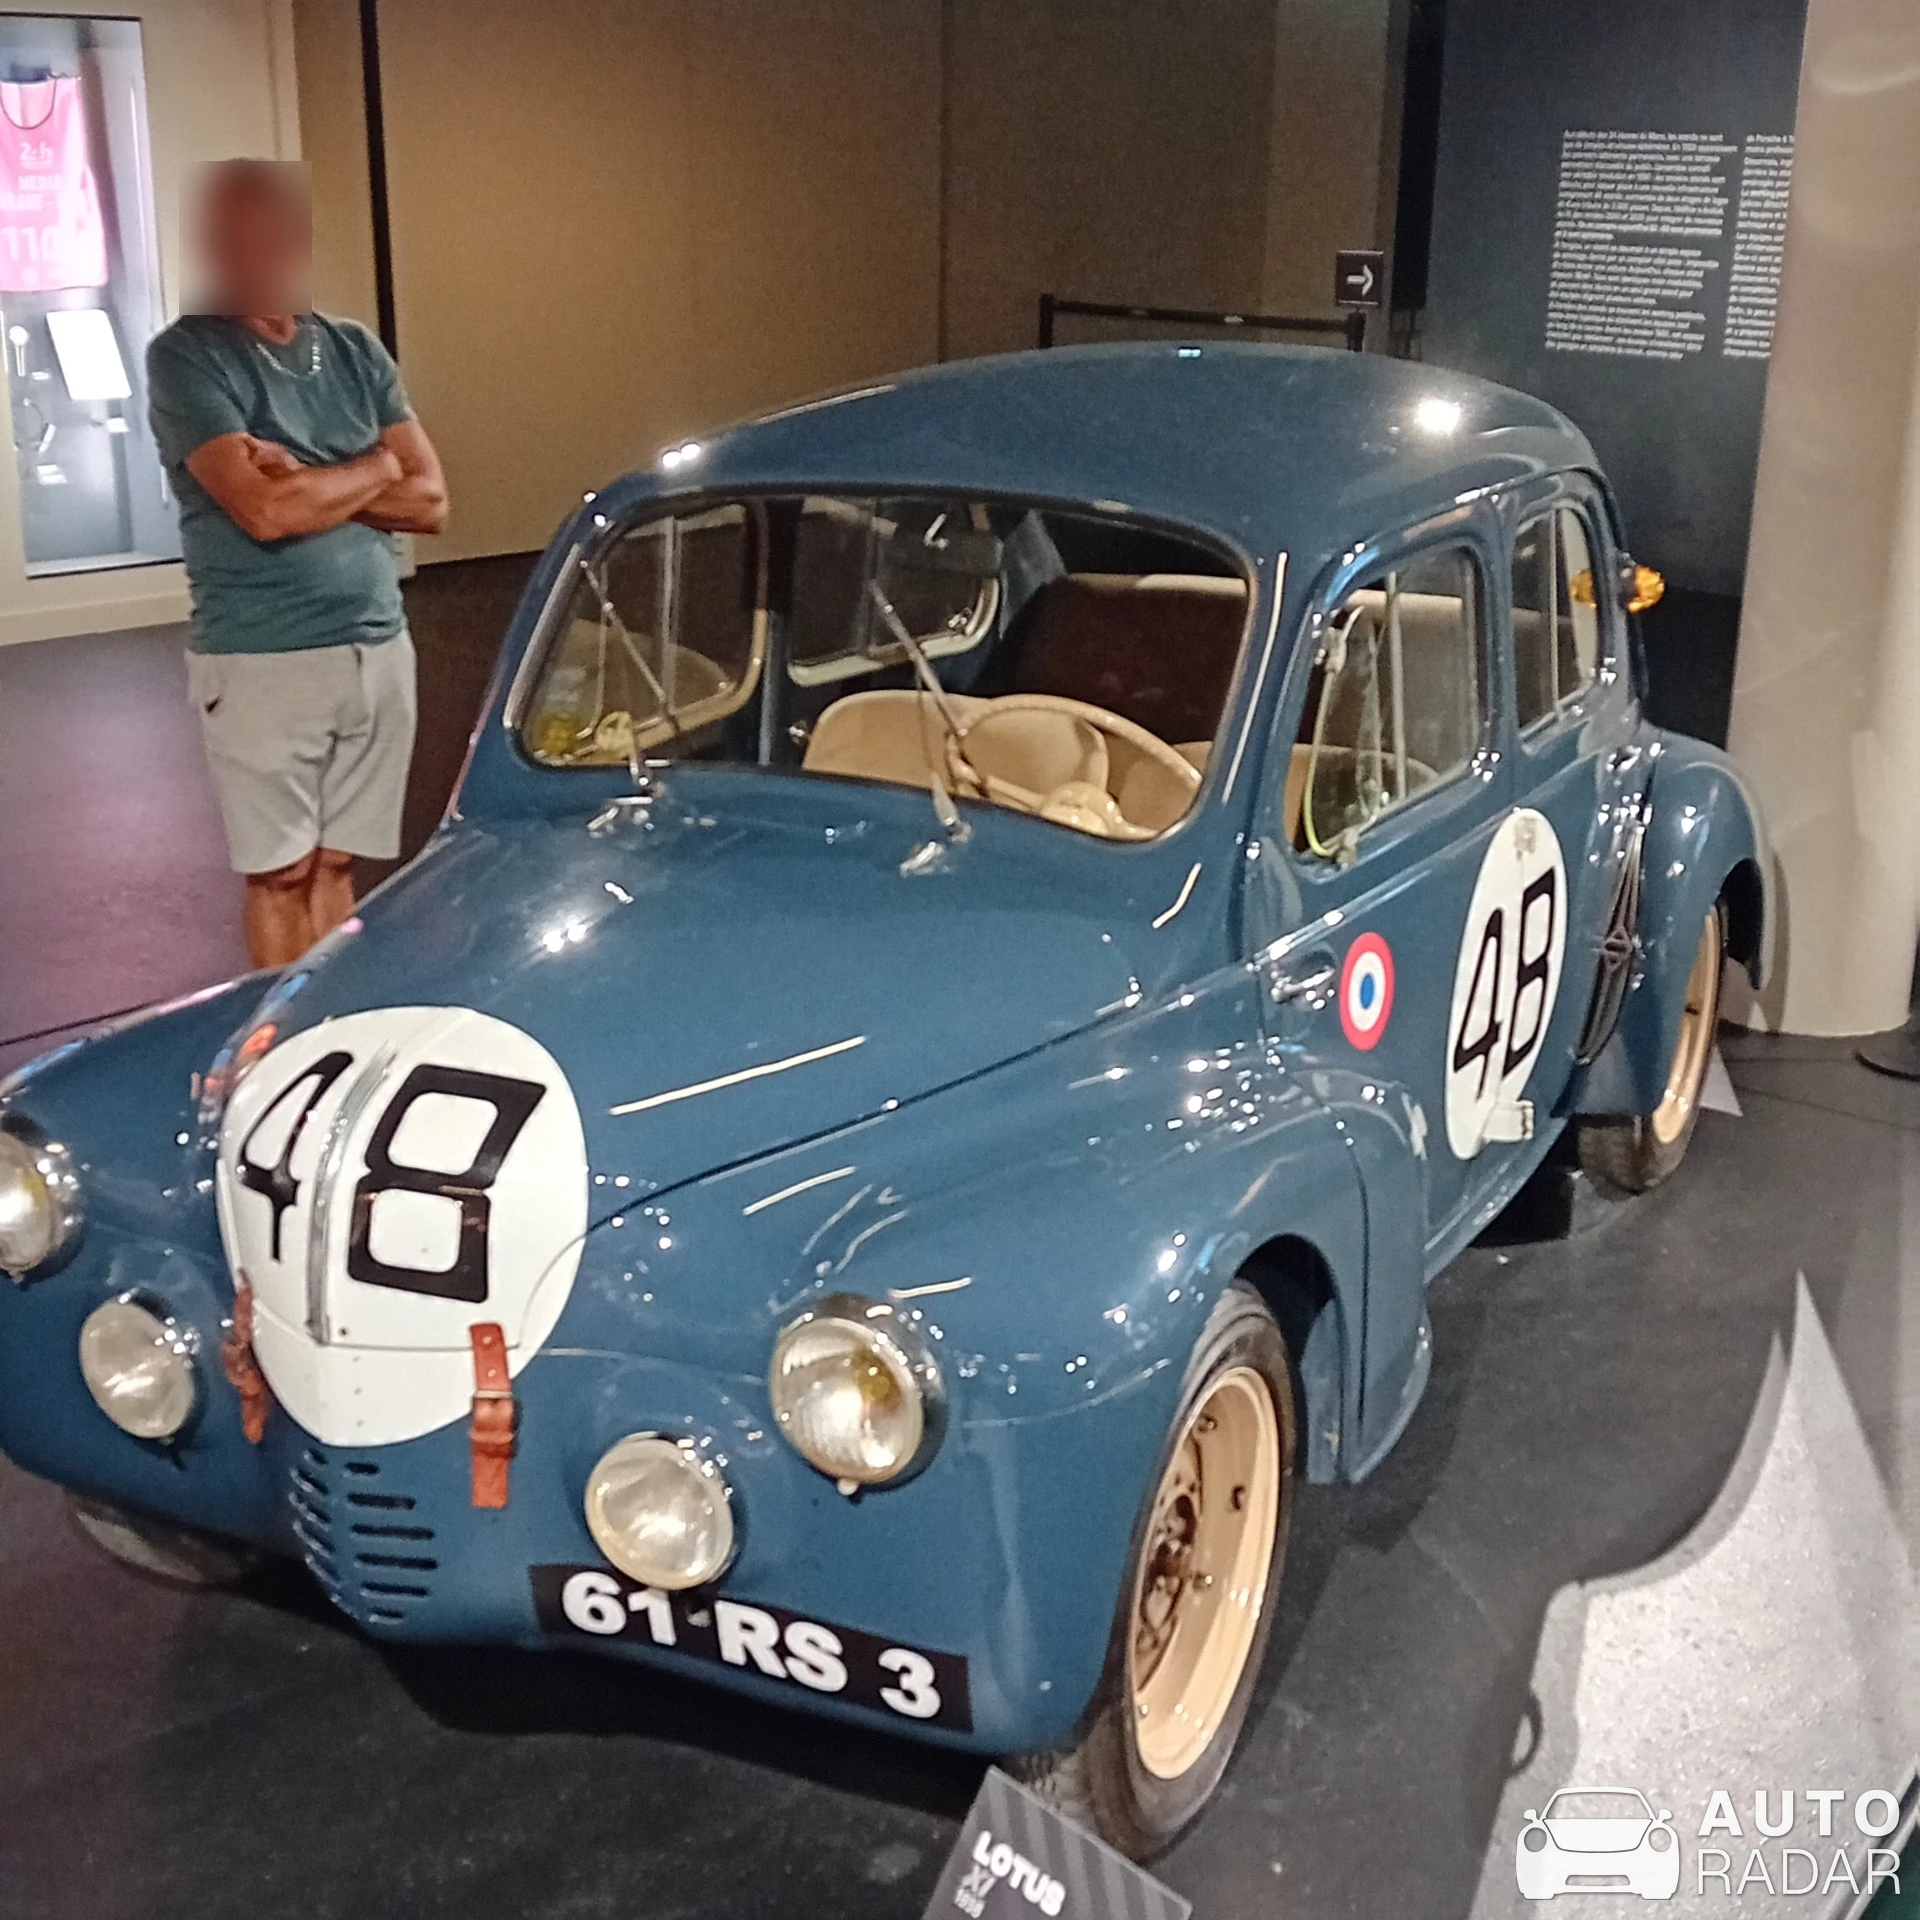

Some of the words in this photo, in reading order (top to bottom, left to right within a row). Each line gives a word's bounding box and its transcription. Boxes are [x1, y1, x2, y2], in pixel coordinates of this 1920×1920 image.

[1453, 866, 1555, 1103] 48
[237, 1050, 547, 1304] 48
[561, 1571, 677, 1646] 61
[714, 1600, 848, 1692] RS
[877, 1648, 942, 1719] 3
[973, 1830, 1067, 1917] LOTUS
